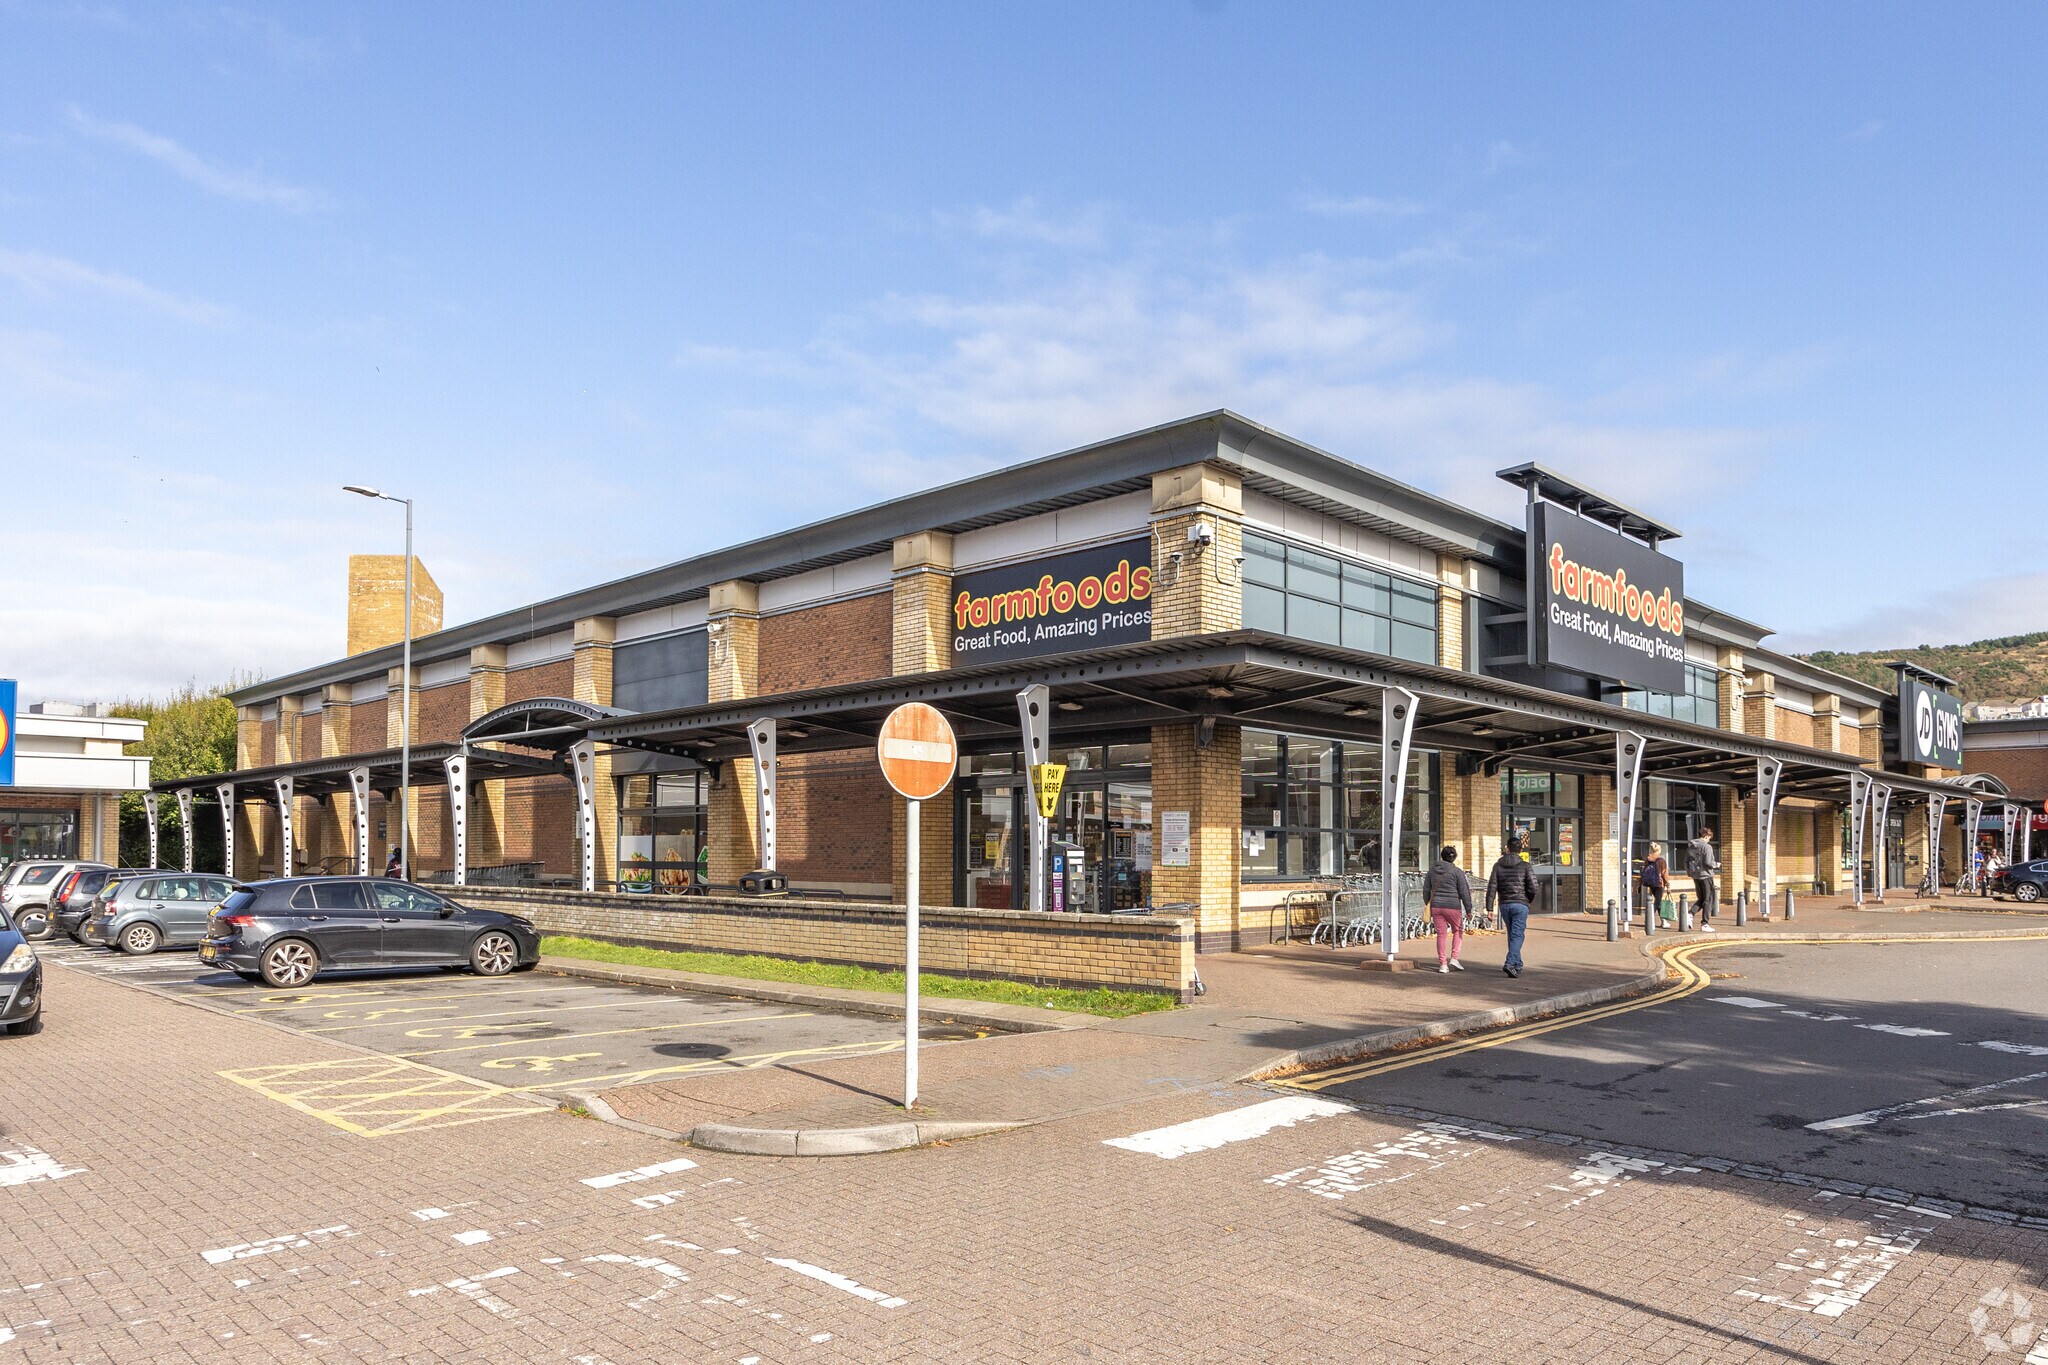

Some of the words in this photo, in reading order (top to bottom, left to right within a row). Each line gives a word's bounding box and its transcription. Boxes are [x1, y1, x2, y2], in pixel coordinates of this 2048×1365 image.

[955, 559, 1151, 630] farmfoods
[1549, 542, 1683, 636] farmfoods
[955, 632, 991, 652] Great
[994, 626, 1031, 646] Food,
[1034, 617, 1098, 640] Amazing
[1102, 610, 1151, 630] Prices
[1550, 602, 1582, 632] Great
[1583, 613, 1612, 645] Food,
[1613, 624, 1655, 659] Amazing
[1656, 636, 1683, 663] Prices
[1936, 708, 1959, 752] GYMS
[1044, 782, 1060, 794] HERE
[1047, 768, 1060, 780] PAY
[1054, 857, 1063, 870] P
